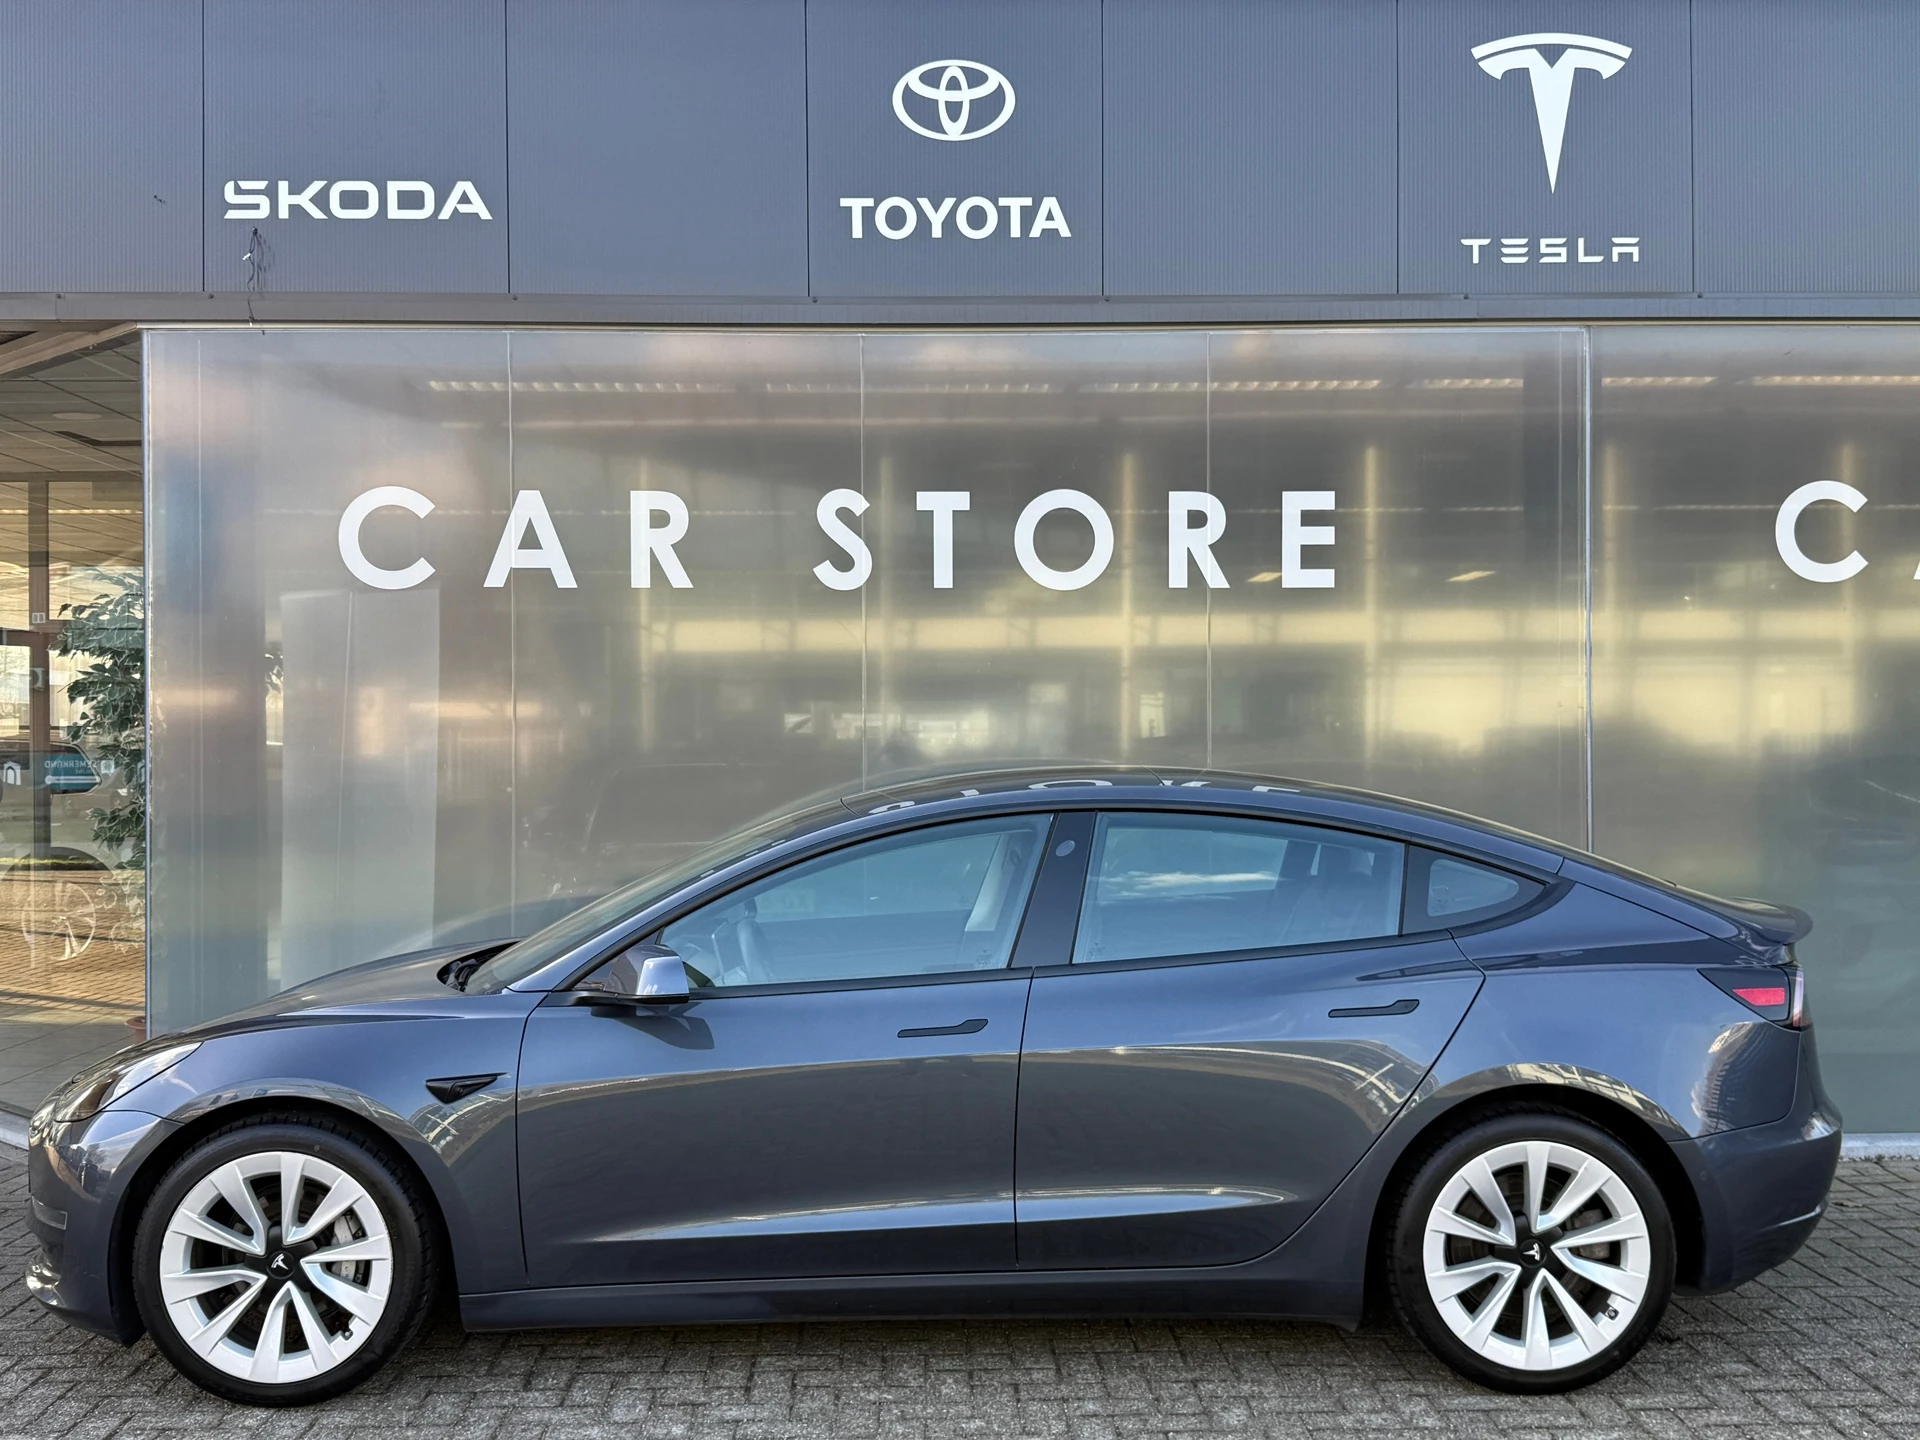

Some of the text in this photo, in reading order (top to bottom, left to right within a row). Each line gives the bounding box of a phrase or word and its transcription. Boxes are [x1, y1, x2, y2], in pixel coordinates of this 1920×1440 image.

[223, 180, 493, 220] SKODA
[839, 196, 1072, 240] TOYOTA
[1460, 237, 1640, 264] TESLA
[338, 485, 1336, 591] CAR STORE
[1775, 480, 1920, 583] C
